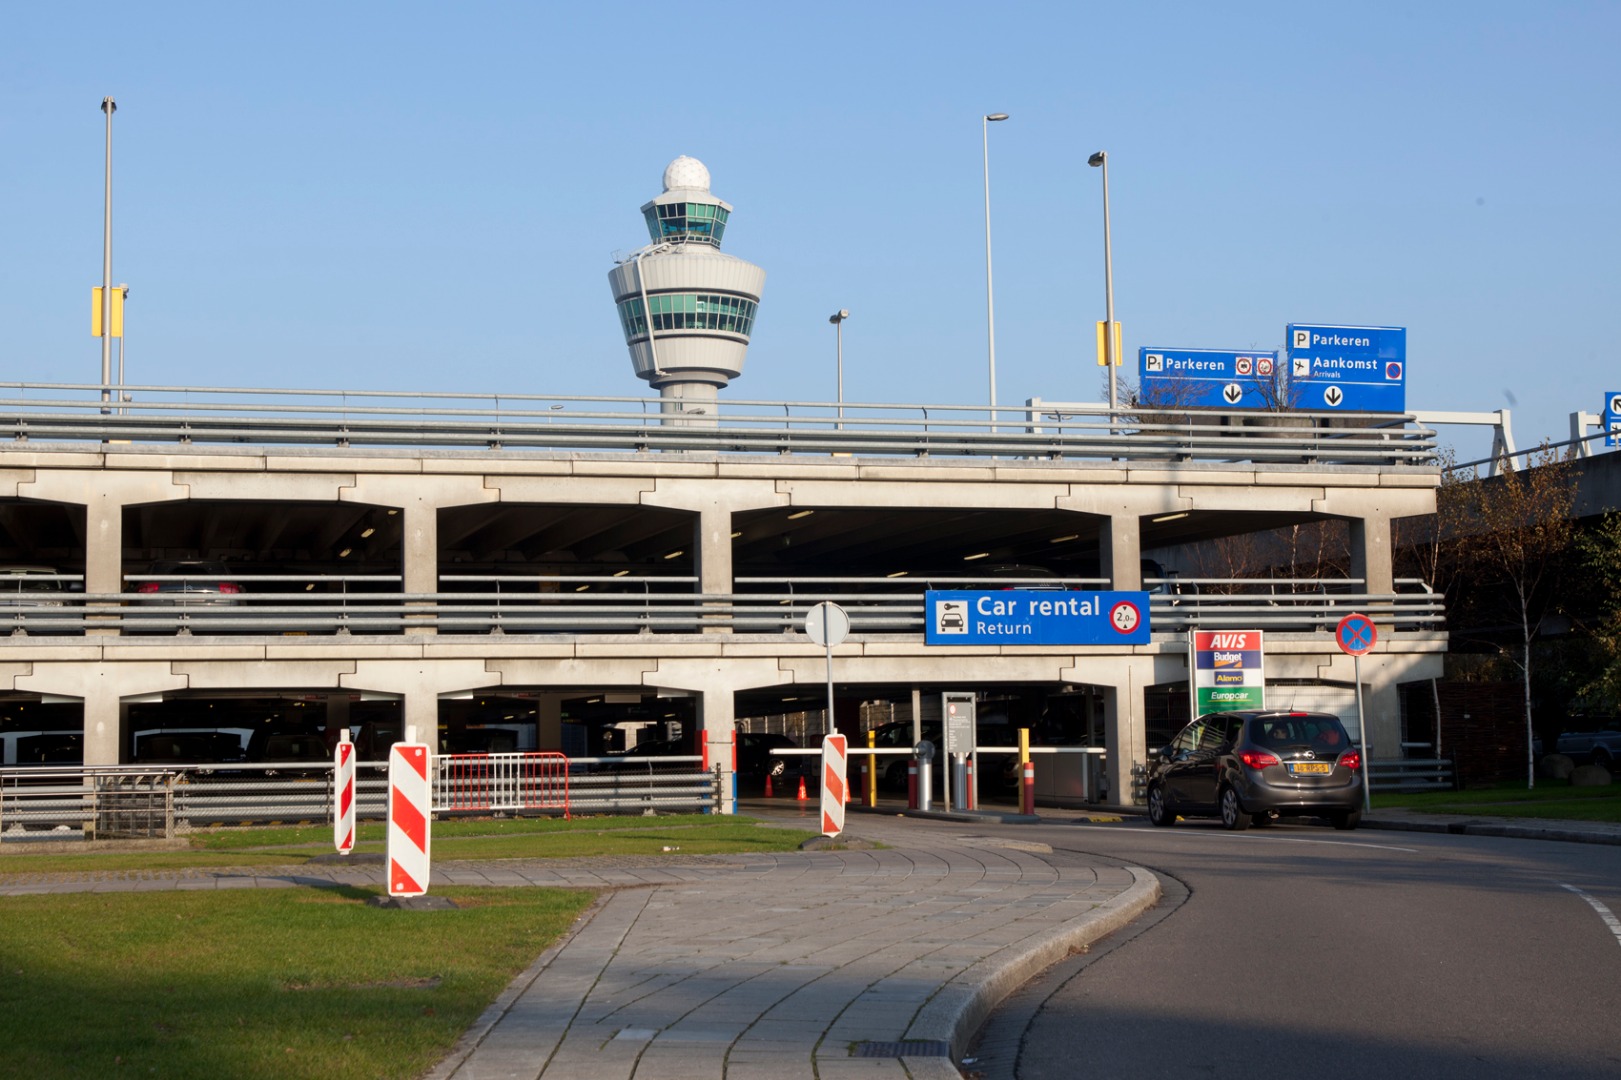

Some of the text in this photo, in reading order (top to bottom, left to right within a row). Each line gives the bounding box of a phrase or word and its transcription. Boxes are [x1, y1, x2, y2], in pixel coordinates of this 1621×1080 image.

[1312, 334, 1370, 347] Parkeren
[1166, 358, 1225, 370] Parkeren
[1313, 357, 1378, 370] Aankomst
[1313, 371, 1341, 379] Arrivals
[976, 595, 1100, 616] Car rental
[976, 621, 1032, 635] Return
[1210, 634, 1247, 649] AVIS
[1213, 652, 1242, 663] Budget
[1211, 692, 1249, 701] Europcar
